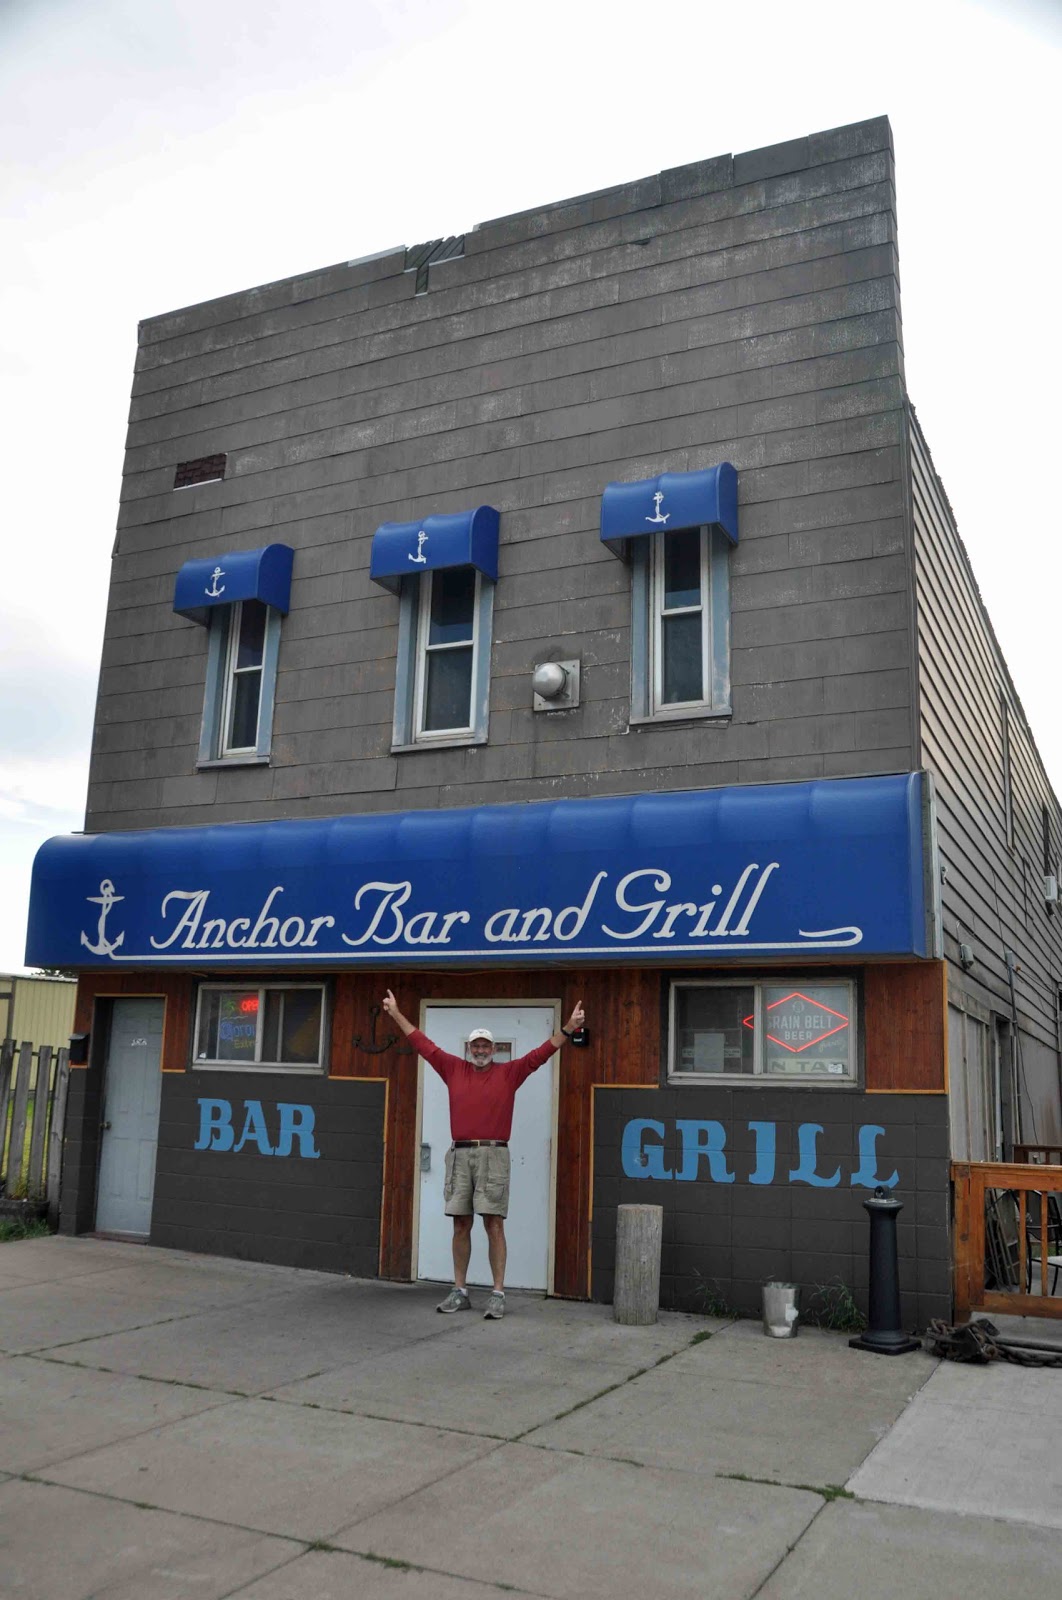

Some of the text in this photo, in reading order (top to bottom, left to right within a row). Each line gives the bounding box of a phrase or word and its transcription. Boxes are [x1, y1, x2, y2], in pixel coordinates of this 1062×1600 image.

[150, 862, 780, 949] Anchor Bar and Grill
[784, 1030, 813, 1040] BEER
[804, 1015, 833, 1029] BELT
[194, 1098, 321, 1158] BAR
[621, 1118, 900, 1188] GRILL
